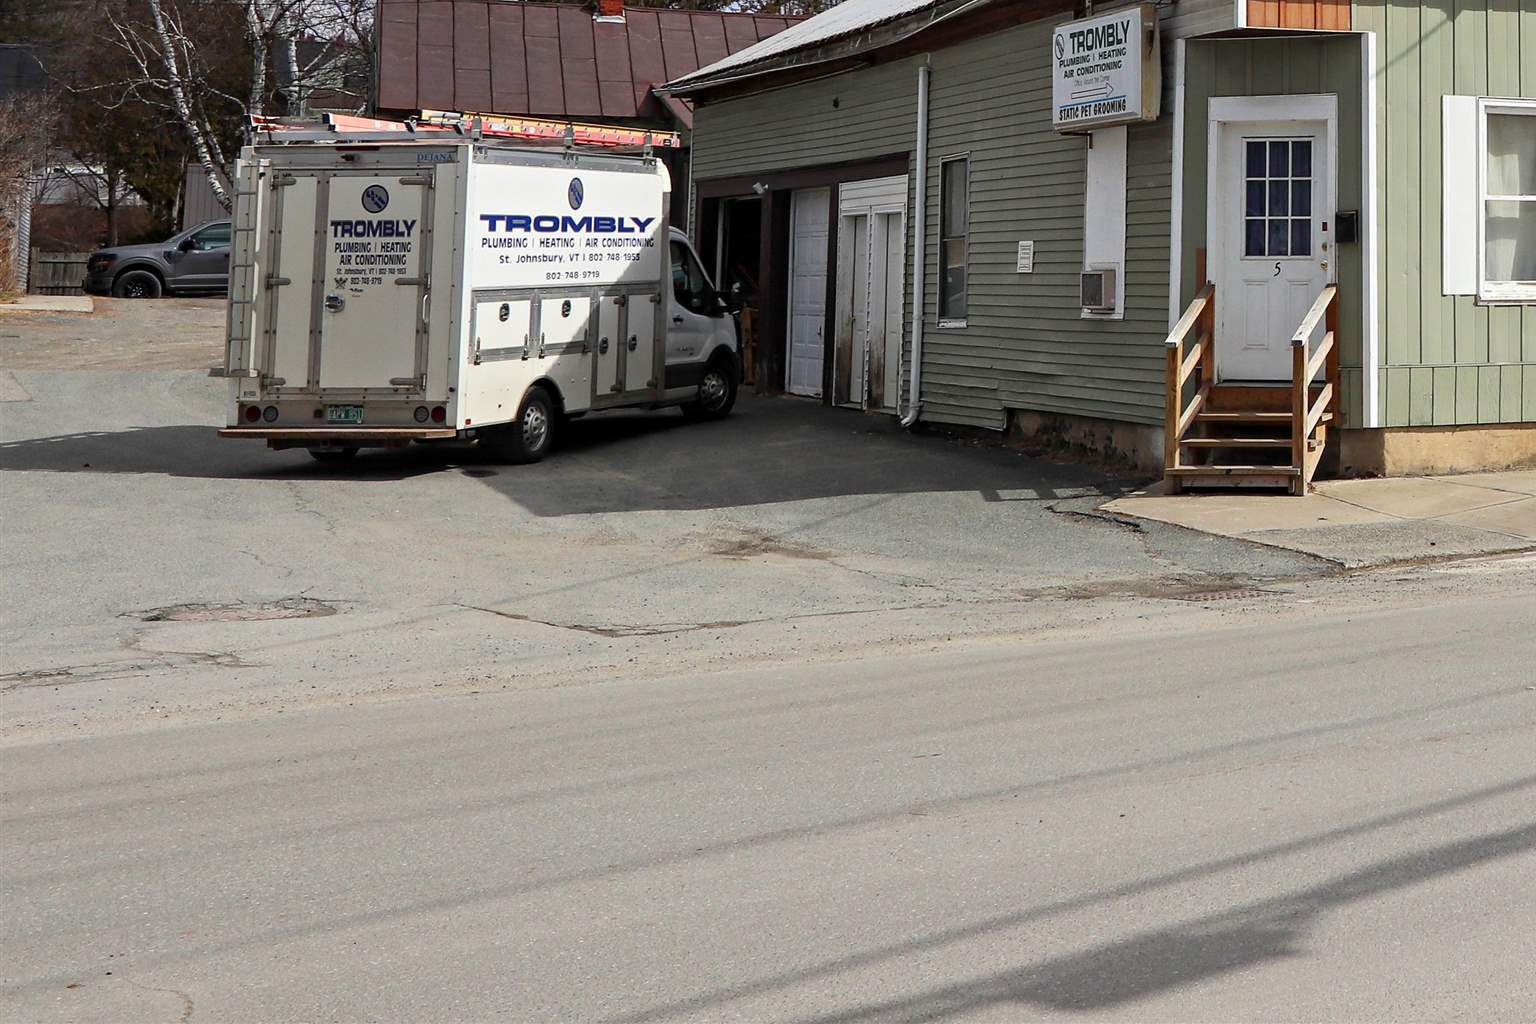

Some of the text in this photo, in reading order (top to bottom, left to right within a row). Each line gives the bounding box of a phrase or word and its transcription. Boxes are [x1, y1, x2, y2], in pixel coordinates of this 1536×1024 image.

[1070, 20, 1130, 54] TROMBLY
[1059, 54, 1091, 68] PLUMBING
[1098, 47, 1127, 60] HEATING
[1064, 60, 1122, 79] AIR CONDITIONING
[1059, 98, 1126, 121] STATIC PET GROOMING
[330, 219, 417, 238] TROMBLY
[480, 214, 656, 233] TROMBLY
[334, 242, 371, 253] PLUMBING
[380, 241, 412, 253] HEATING
[481, 237, 528, 248] PLUMBING
[540, 238, 575, 248] HEATING
[585, 238, 598, 247] AIR
[602, 238, 655, 248] CONDITIONING
[339, 254, 407, 266] AIR CONDITIONING
[499, 255, 512, 264] St.
[516, 254, 566, 264] Johnsbury,
[569, 253, 580, 262] VT
[546, 271, 600, 280] 802-748-9719
[1273, 262, 1281, 277] 5
